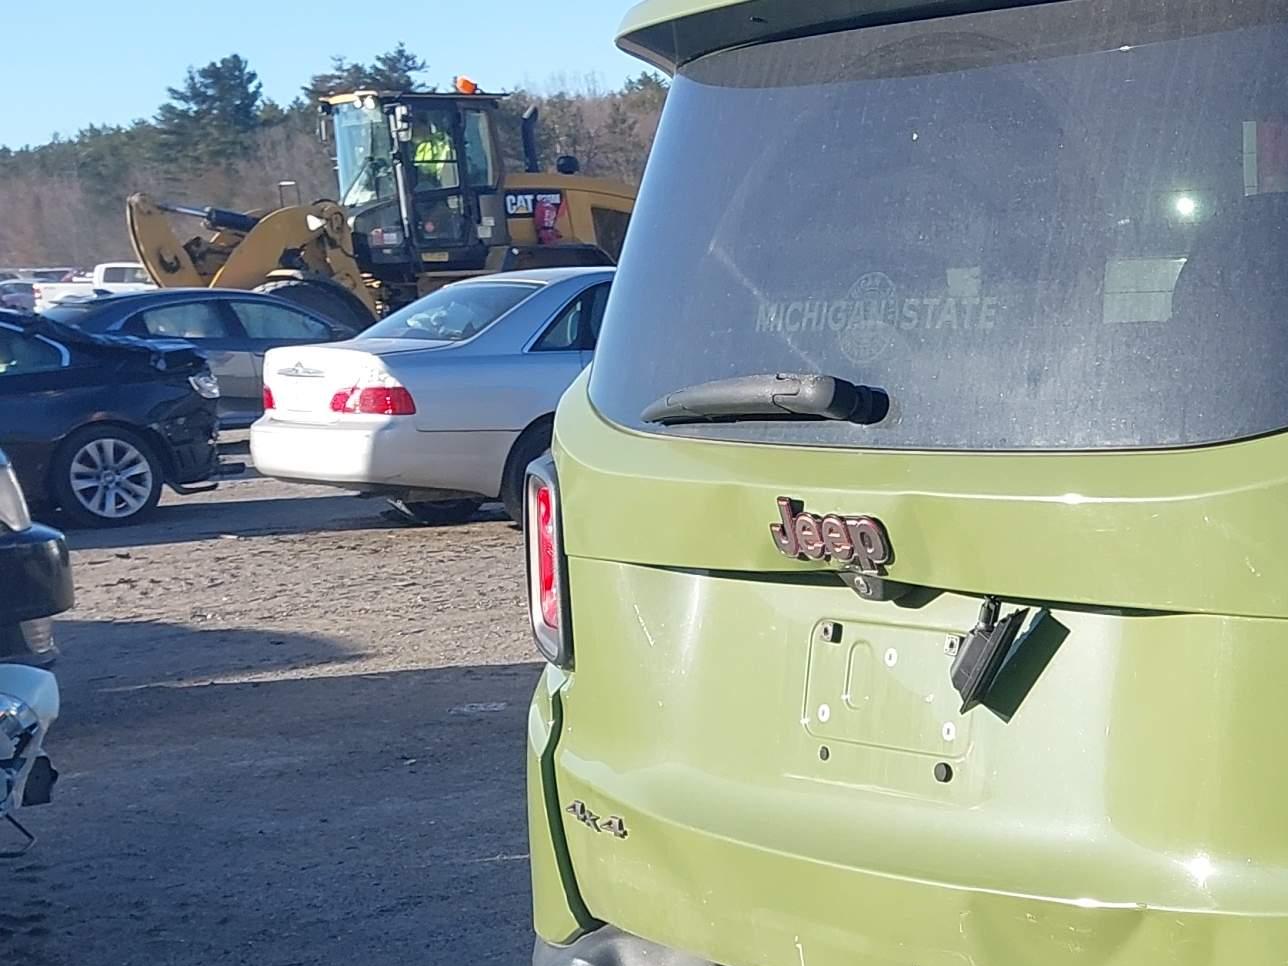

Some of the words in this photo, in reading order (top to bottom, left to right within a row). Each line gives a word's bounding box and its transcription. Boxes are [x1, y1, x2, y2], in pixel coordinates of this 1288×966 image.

[505, 194, 534, 215] CAT
[755, 299, 893, 332] MICHIGAN
[900, 297, 998, 330] STATE
[769, 496, 894, 575] Jeep
